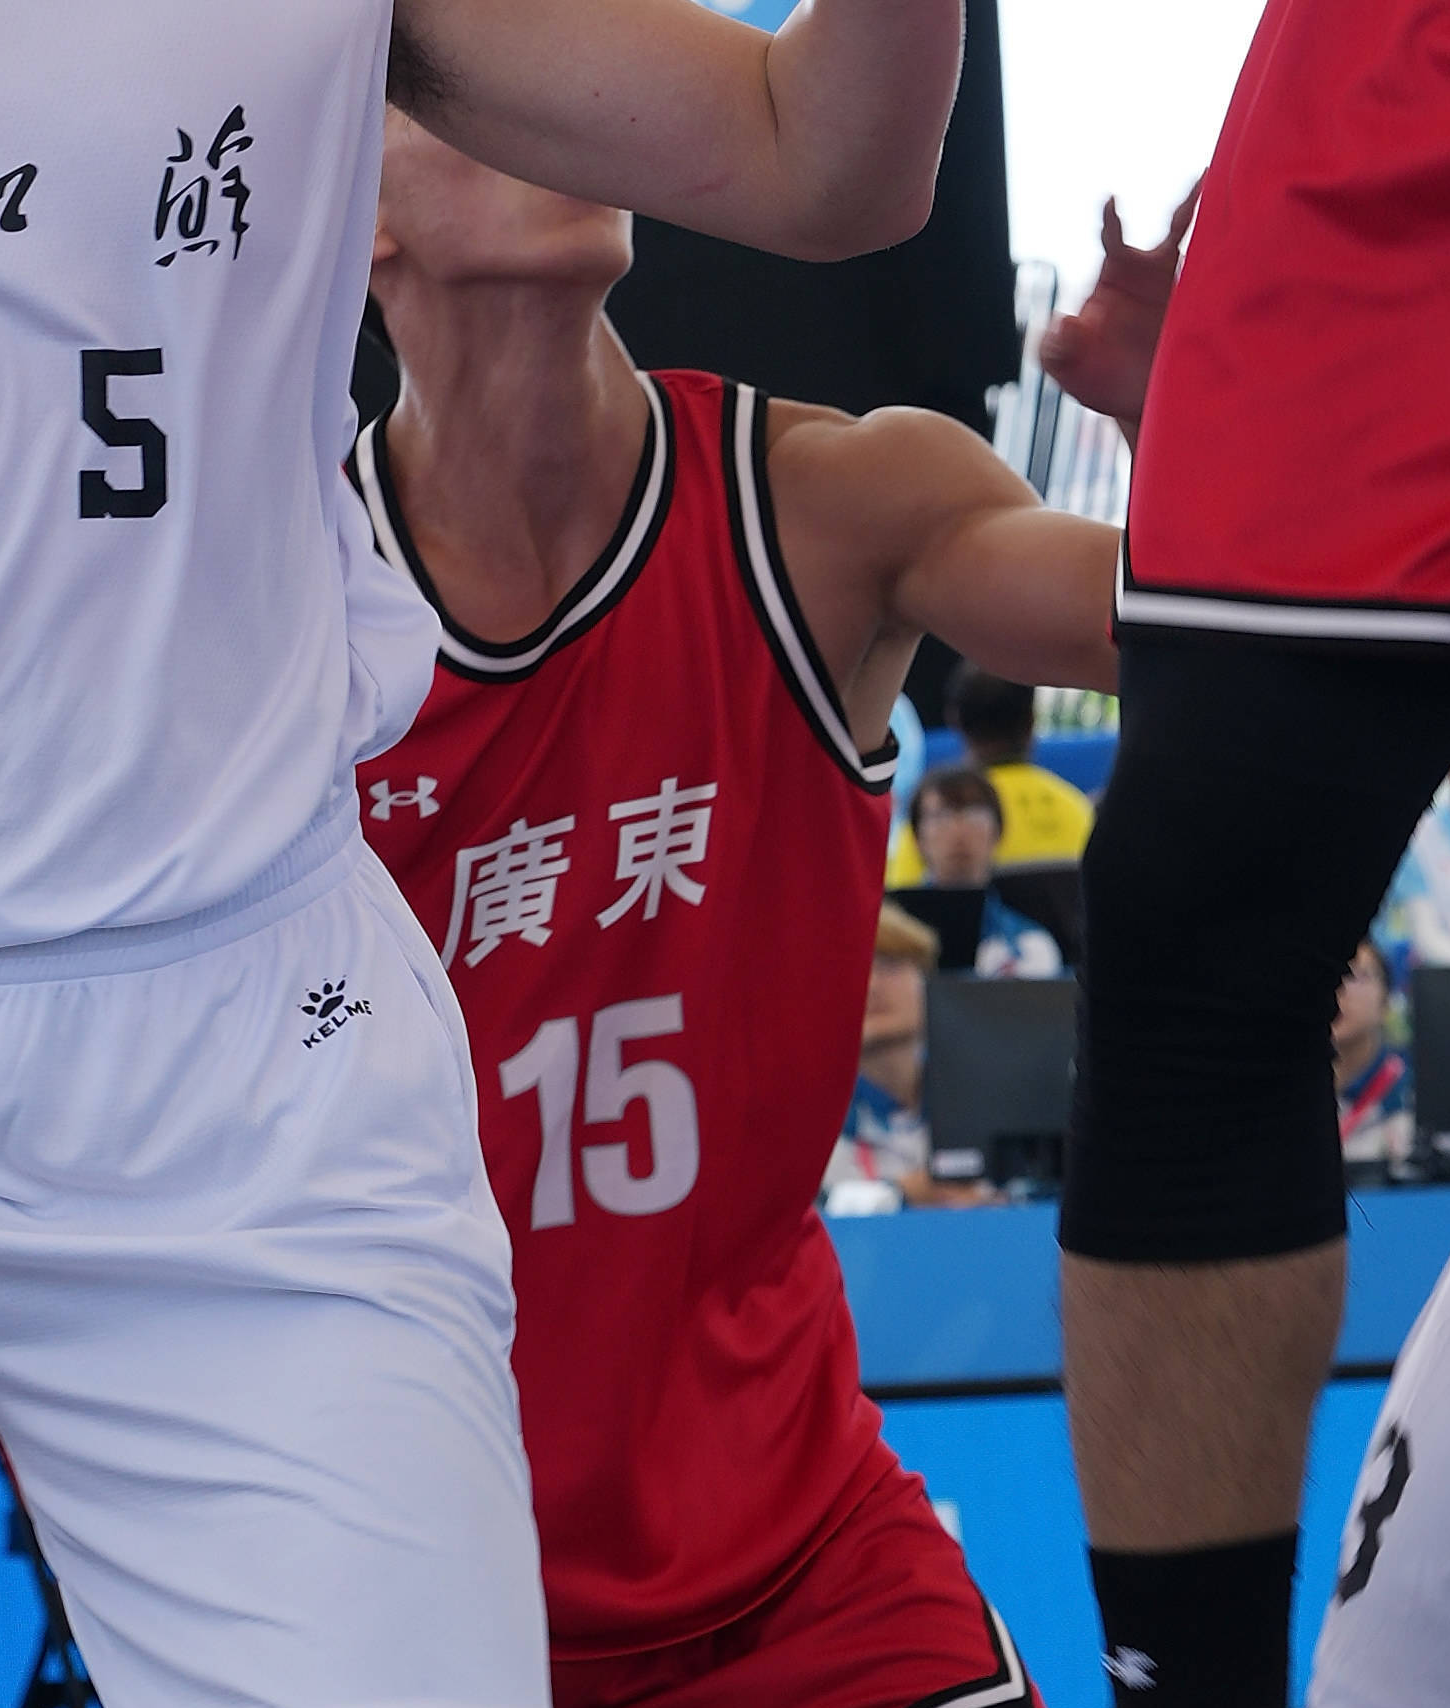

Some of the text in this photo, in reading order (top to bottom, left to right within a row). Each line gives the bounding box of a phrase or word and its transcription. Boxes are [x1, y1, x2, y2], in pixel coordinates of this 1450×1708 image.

[79, 348, 167, 519] 5
[440, 775, 719, 971] 廣東
[301, 1000, 373, 1050] KELME
[498, 992, 701, 1232] 15
